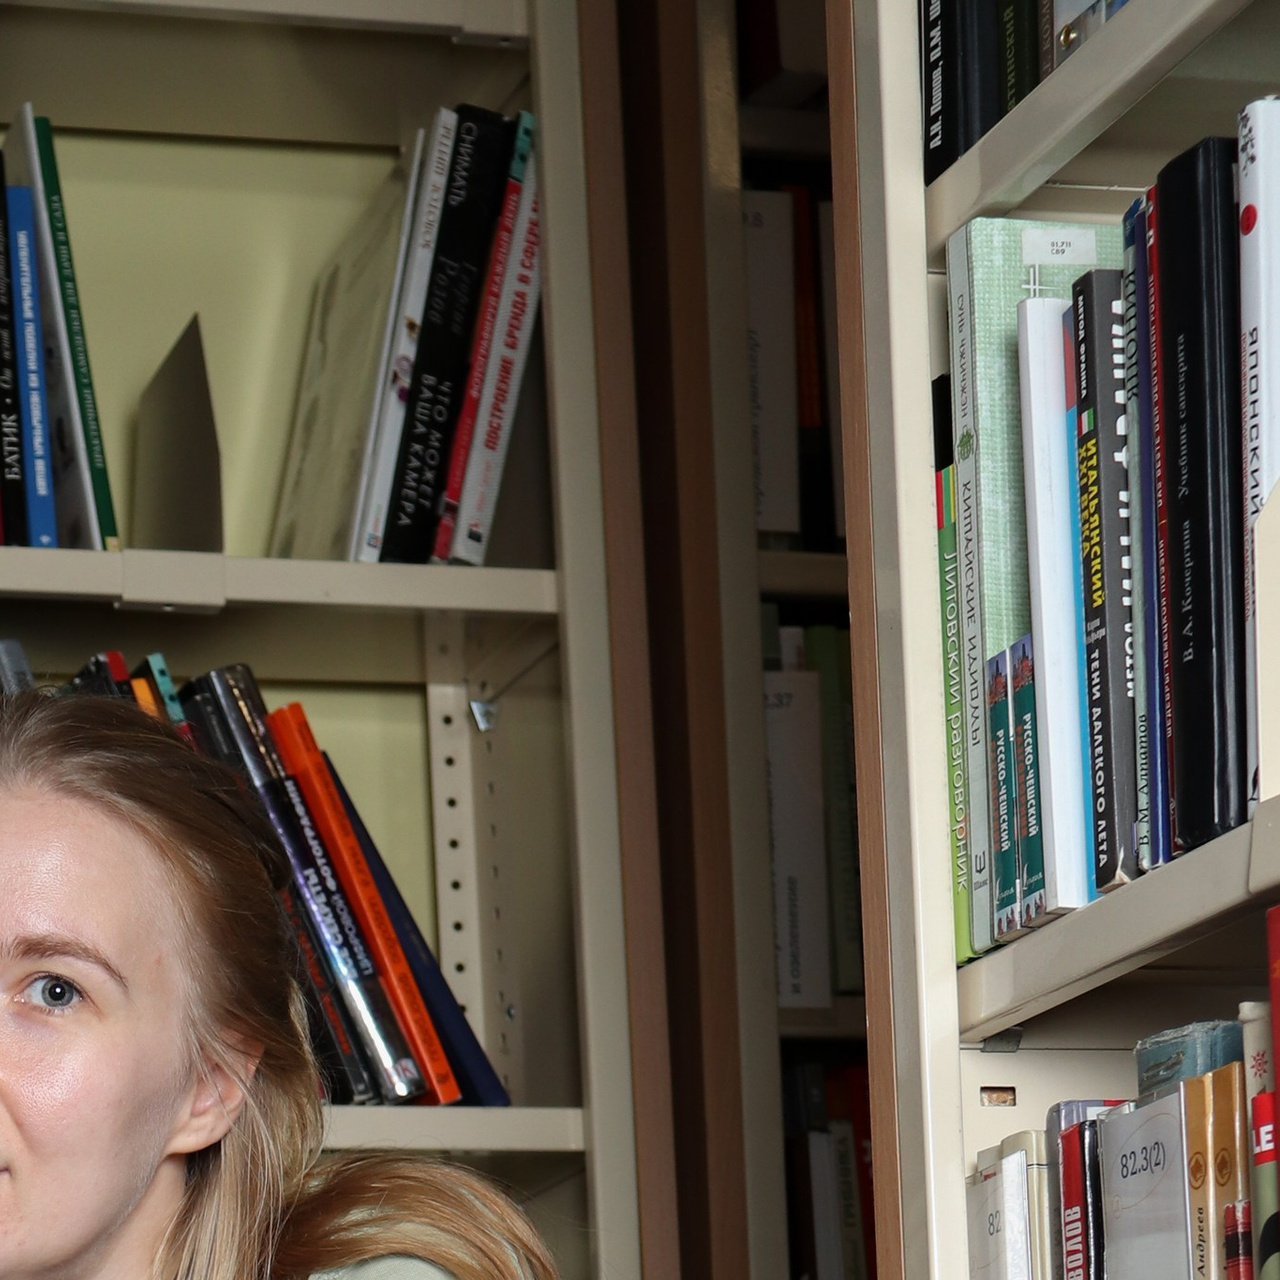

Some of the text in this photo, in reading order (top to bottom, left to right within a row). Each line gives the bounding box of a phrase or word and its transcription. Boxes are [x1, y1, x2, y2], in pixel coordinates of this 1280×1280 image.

[2, 415, 21, 480] БАТИК
[944, 553, 967, 890] Литовский разговорник
[1089, 650, 1108, 866] ТЕНИ ДАЛЕКОГО ЛЕТА
[1120, 1141, 1165, 1180] 82.3(2)
[988, 1212, 1000, 1236] 82
